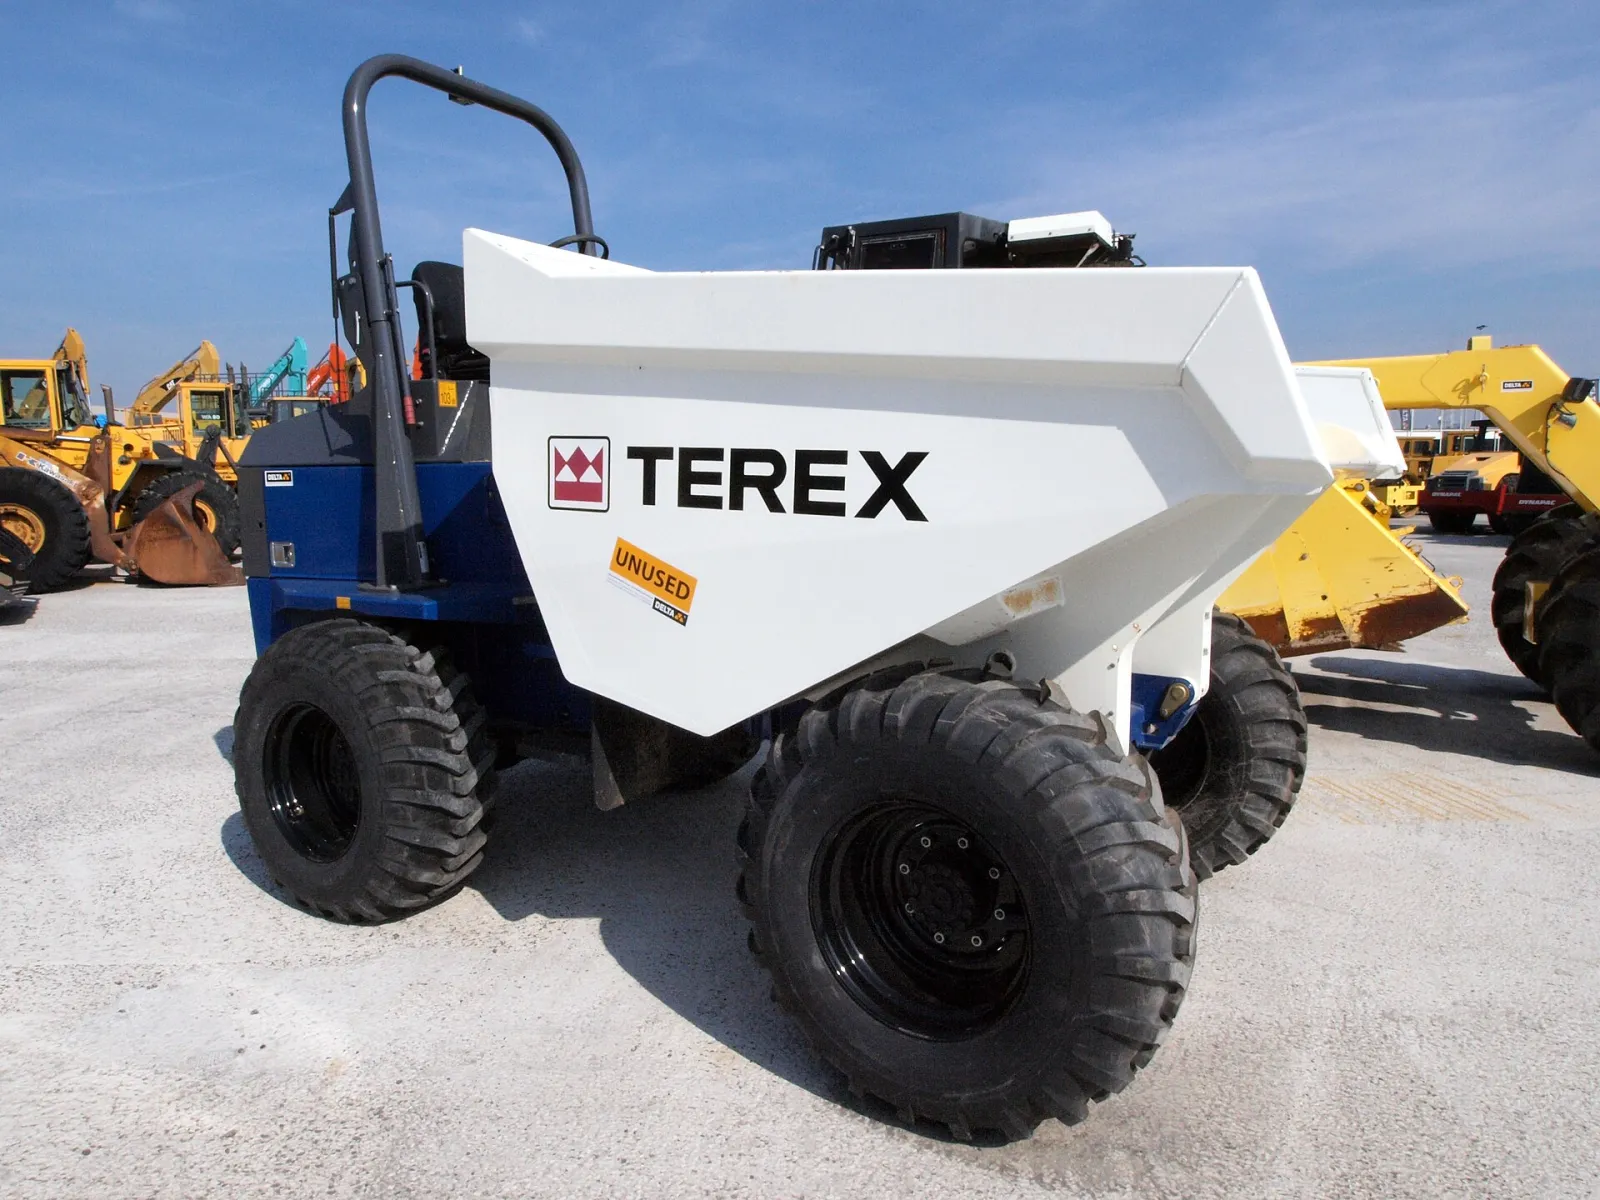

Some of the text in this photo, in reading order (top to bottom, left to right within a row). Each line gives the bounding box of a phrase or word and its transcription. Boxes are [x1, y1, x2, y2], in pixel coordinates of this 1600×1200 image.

[267, 473, 283, 481] DELTA
[627, 446, 930, 522] TEREX
[615, 547, 691, 600] UNUSED
[654, 600, 675, 617] DELTA
